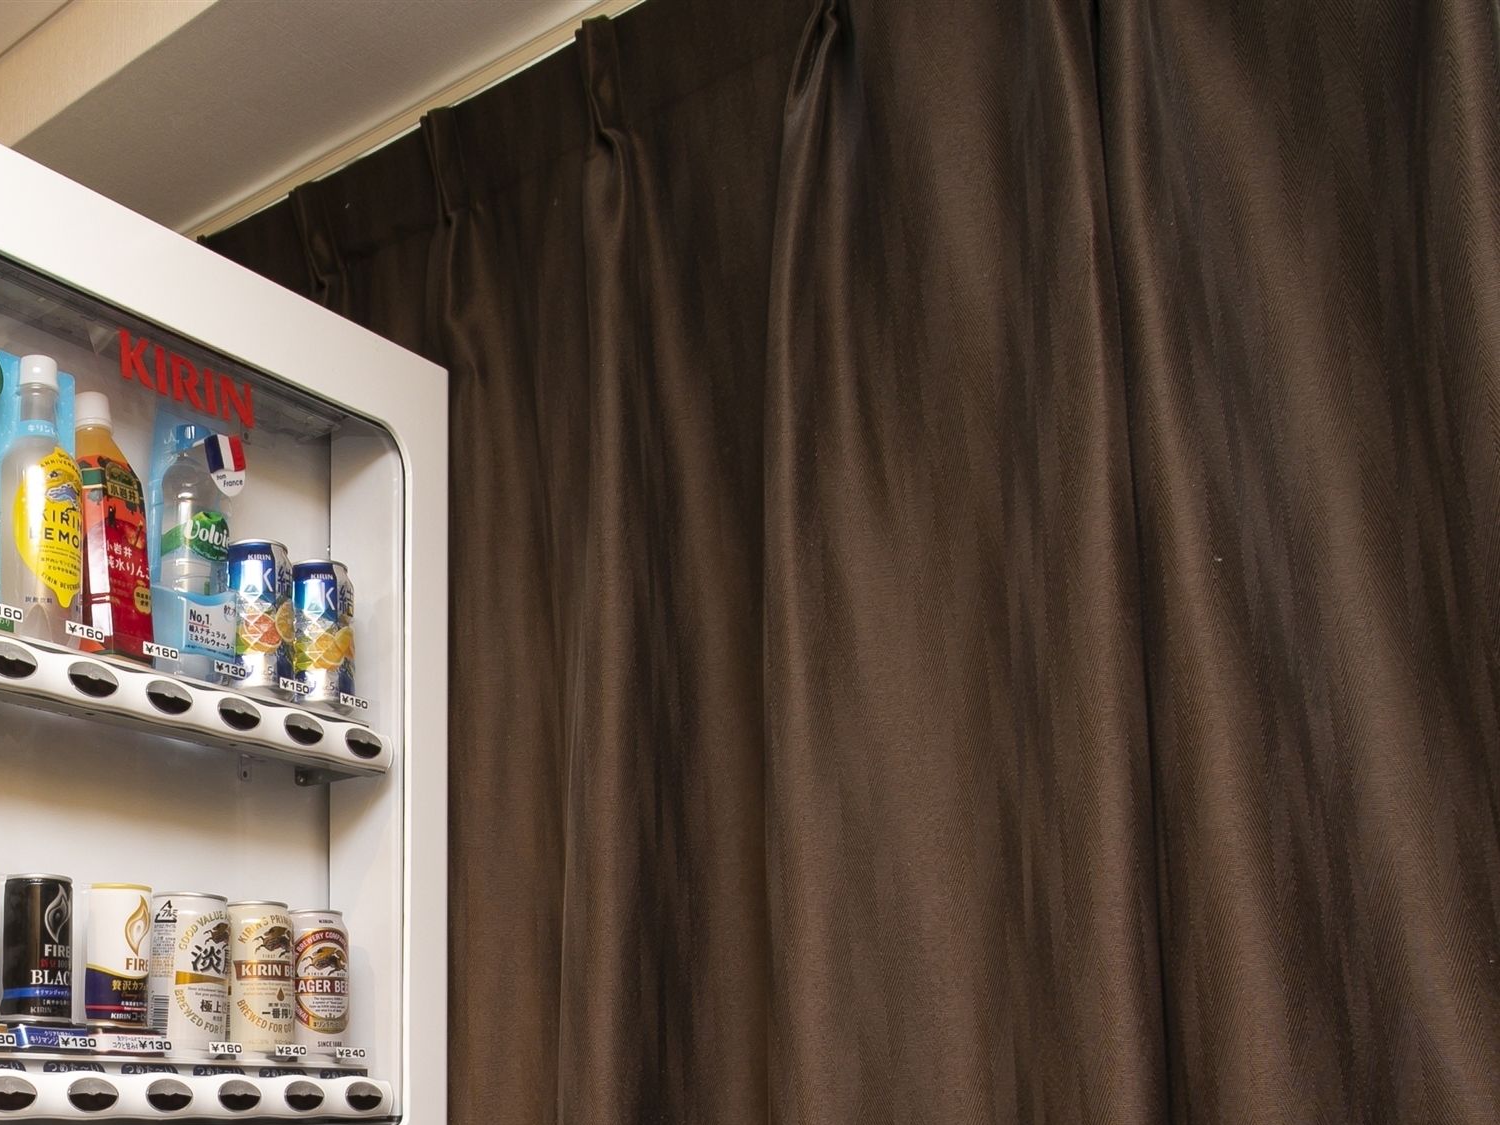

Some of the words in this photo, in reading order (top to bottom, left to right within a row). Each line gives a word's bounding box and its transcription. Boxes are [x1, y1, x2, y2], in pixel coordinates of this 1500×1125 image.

[118, 326, 256, 430] KIRIN
[247, 553, 272, 561] KIRIN
[310, 573, 334, 581] KIRIN
[68, 622, 104, 641] ¥160
[145, 644, 179, 660] ¥160
[296, 932, 324, 953] BREWERY
[241, 964, 282, 977] KIRIN
[295, 979, 331, 993] AGER
[174, 989, 204, 1027] BREWED
[237, 999, 268, 1029] BREWED
[268, 1023, 283, 1033] FOR
[61, 1037, 97, 1048] ¥130
[139, 1040, 172, 1050] ¥130
[211, 1043, 242, 1053] ¥160
[277, 1046, 307, 1055] ¥240
[338, 1048, 366, 1058] ¥240
